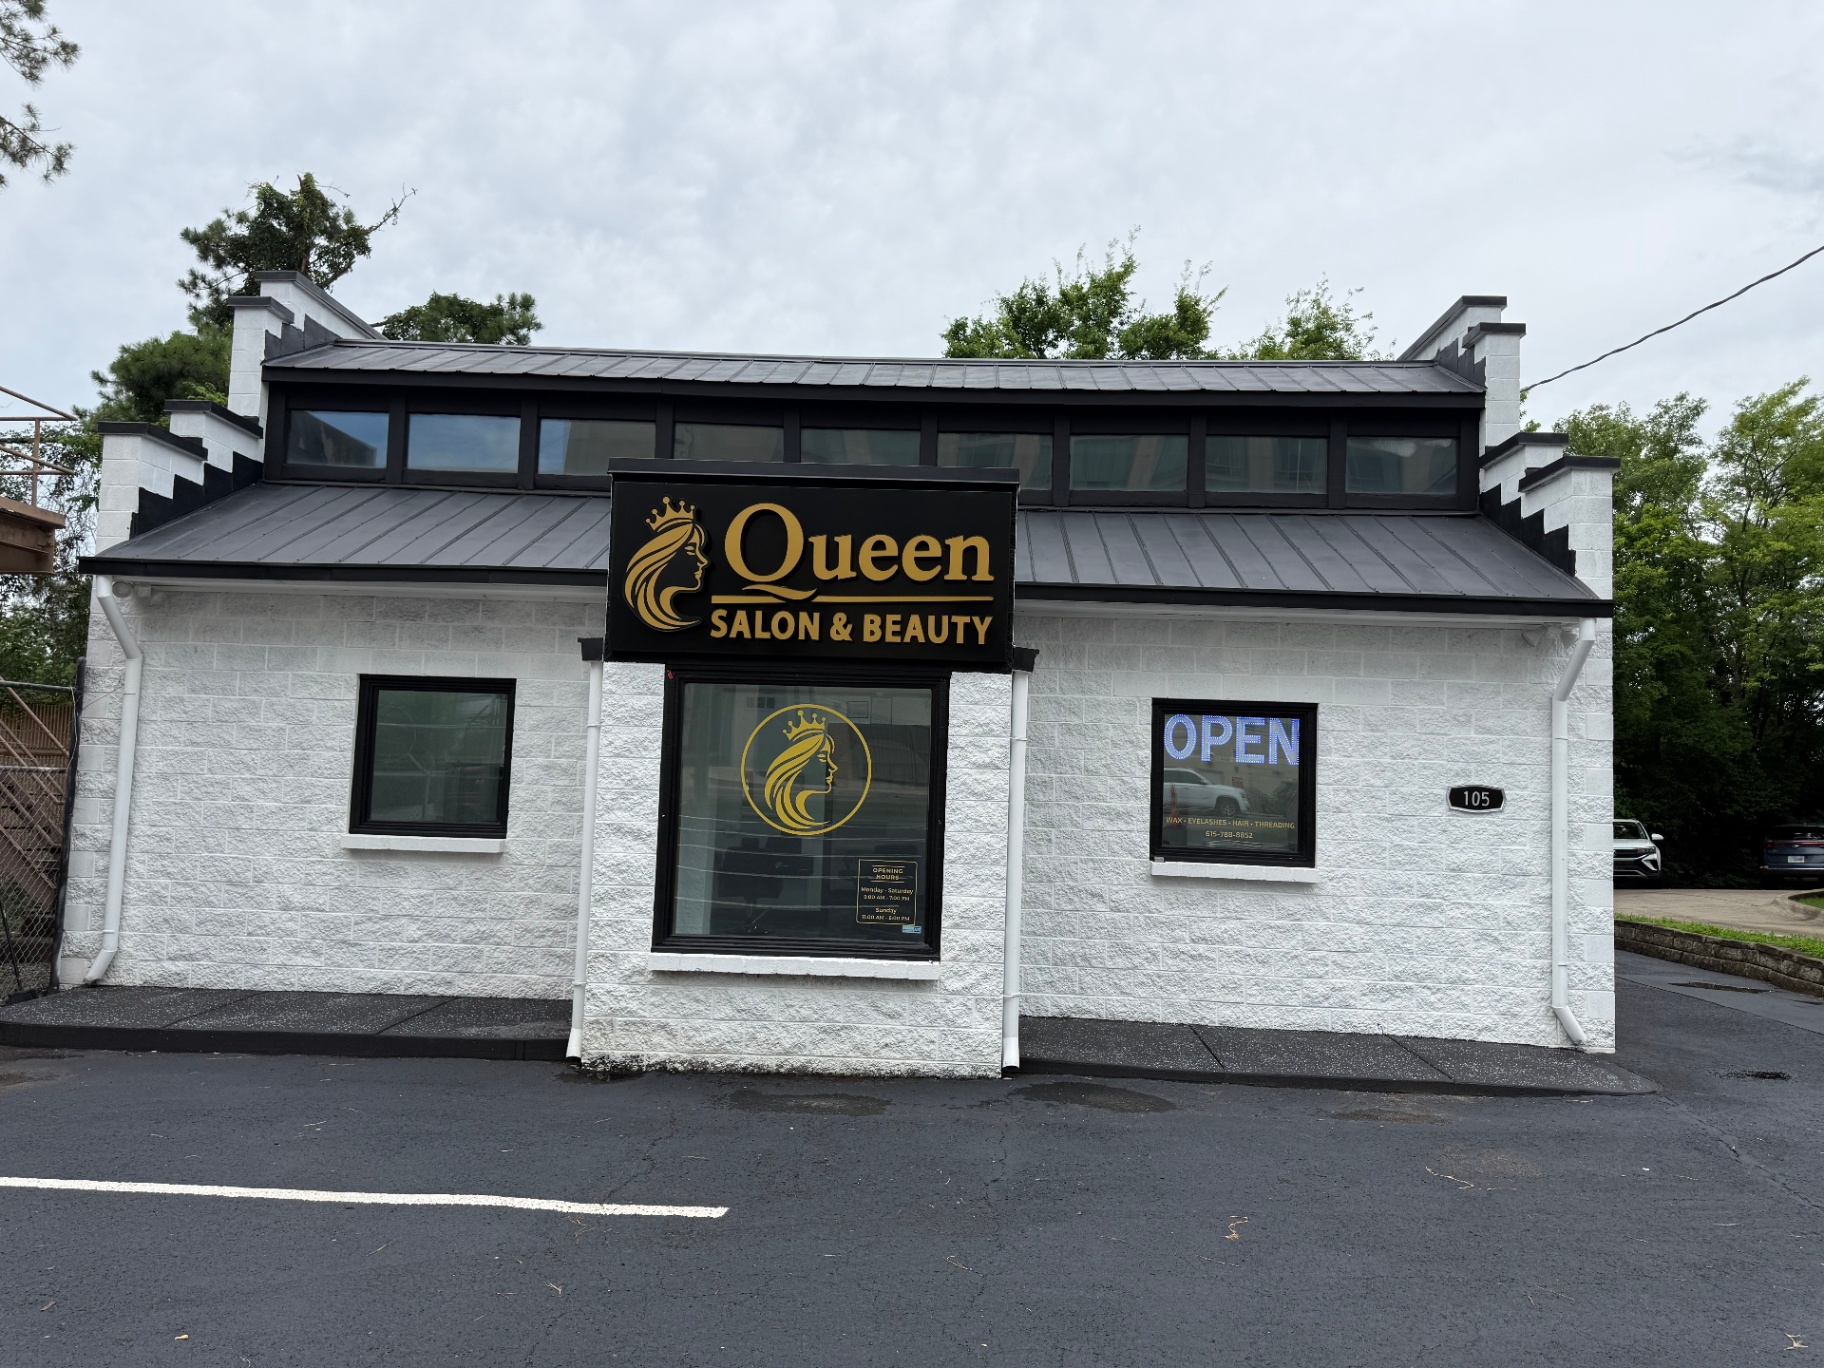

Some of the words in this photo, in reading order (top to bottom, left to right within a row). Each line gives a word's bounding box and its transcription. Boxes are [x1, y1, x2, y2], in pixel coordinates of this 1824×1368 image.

[724, 502, 995, 600] Queen
[710, 609, 821, 641] SALON
[829, 616, 853, 642] &
[862, 614, 994, 645] BEAUTY
[1163, 713, 1301, 766] OPEN
[1463, 790, 1490, 807] 105
[1165, 816, 1183, 824] WAX
[1187, 817, 1227, 826] EYELASHES
[1232, 819, 1249, 827] HAIR
[1255, 821, 1295, 829] THREADING
[887, 887, 914, 895] Saturday
